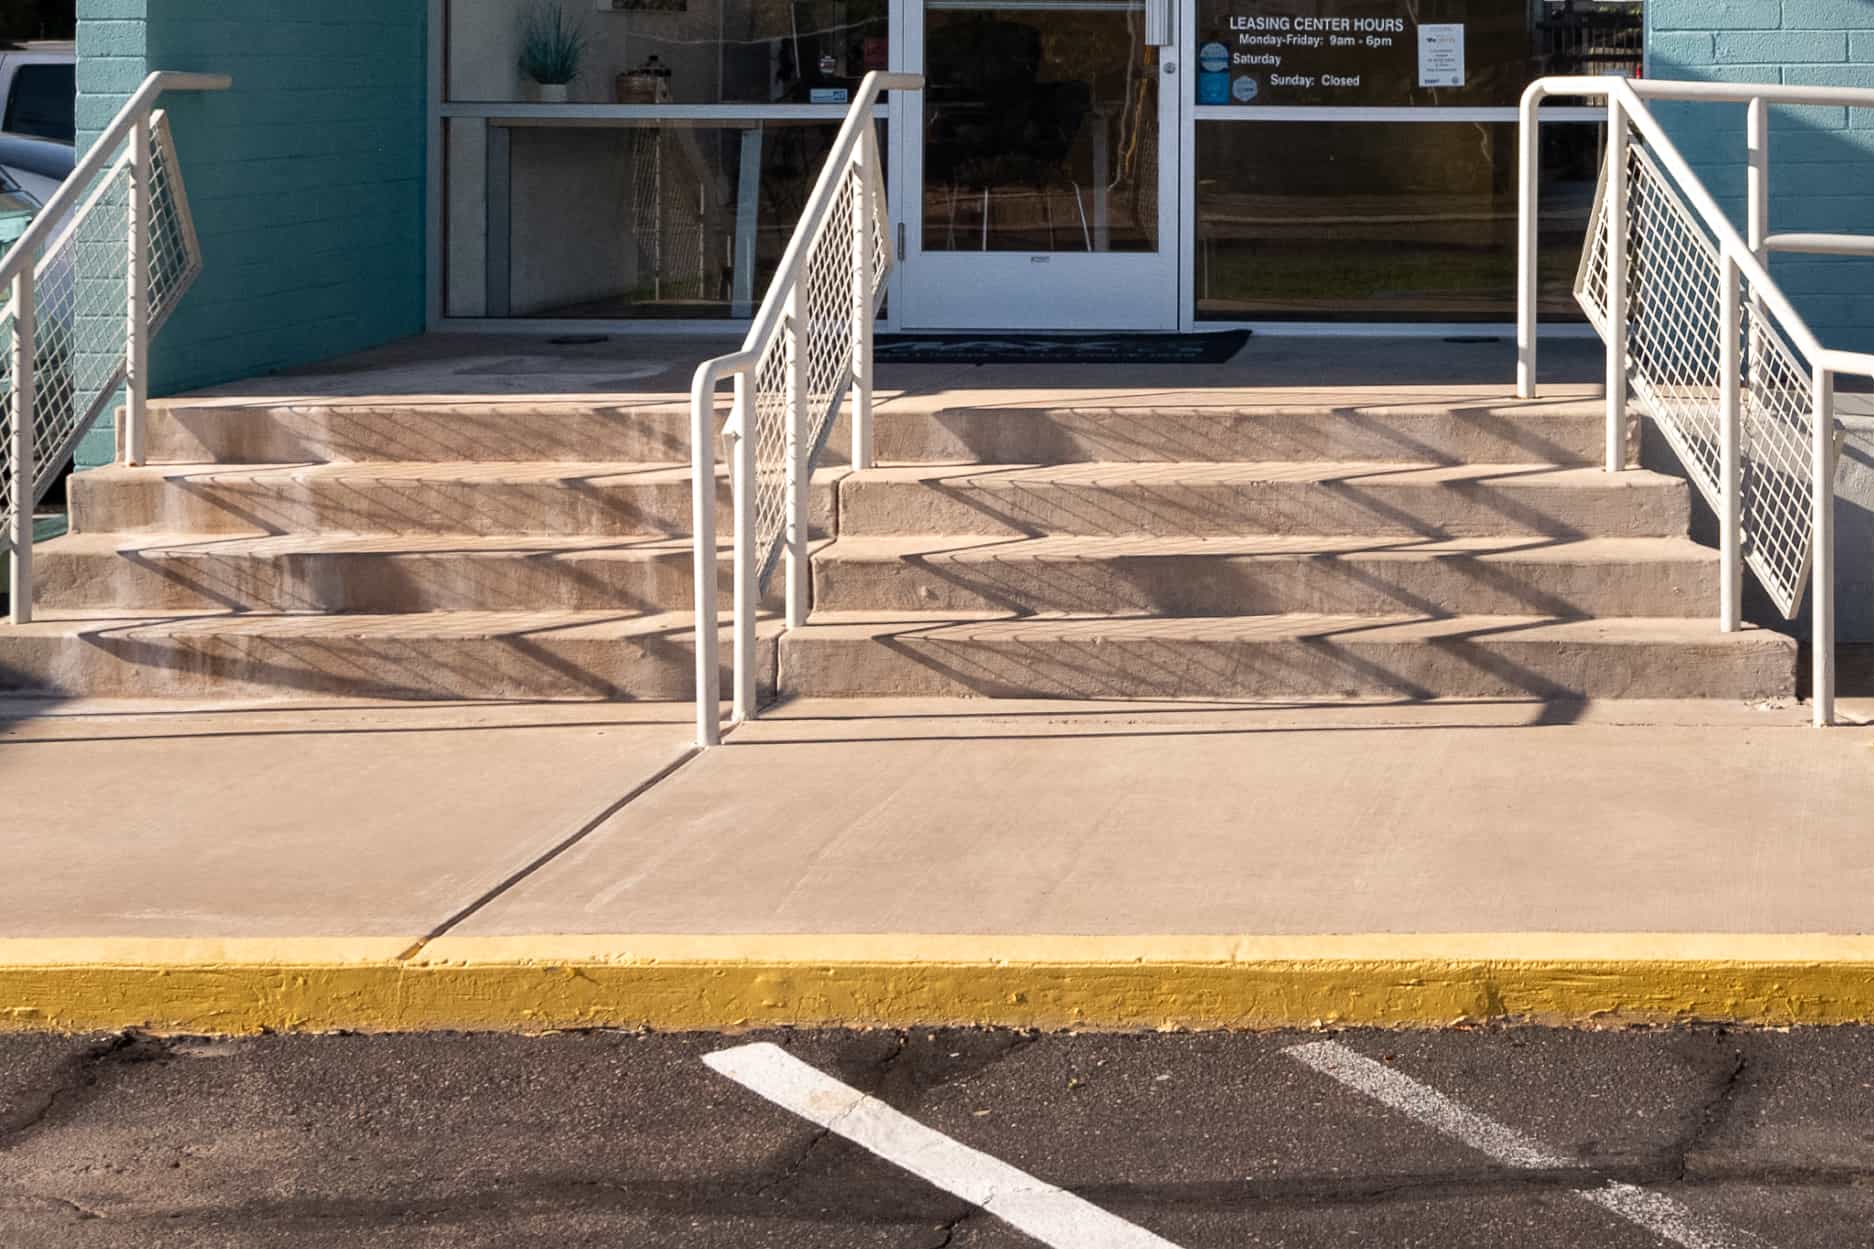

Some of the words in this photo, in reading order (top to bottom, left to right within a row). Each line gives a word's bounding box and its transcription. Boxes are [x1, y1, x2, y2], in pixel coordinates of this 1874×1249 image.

[1229, 16, 1291, 31] LEASING
[1294, 17, 1350, 31] CENTER
[1353, 18, 1404, 32] HOURS
[1239, 33, 1324, 48] Monday-Friday:
[1329, 34, 1356, 46] 9am
[1365, 35, 1393, 49] 6pm
[1233, 52, 1282, 68] Saturday
[1270, 73, 1315, 89] Sunday:
[1321, 74, 1360, 87] Closed
